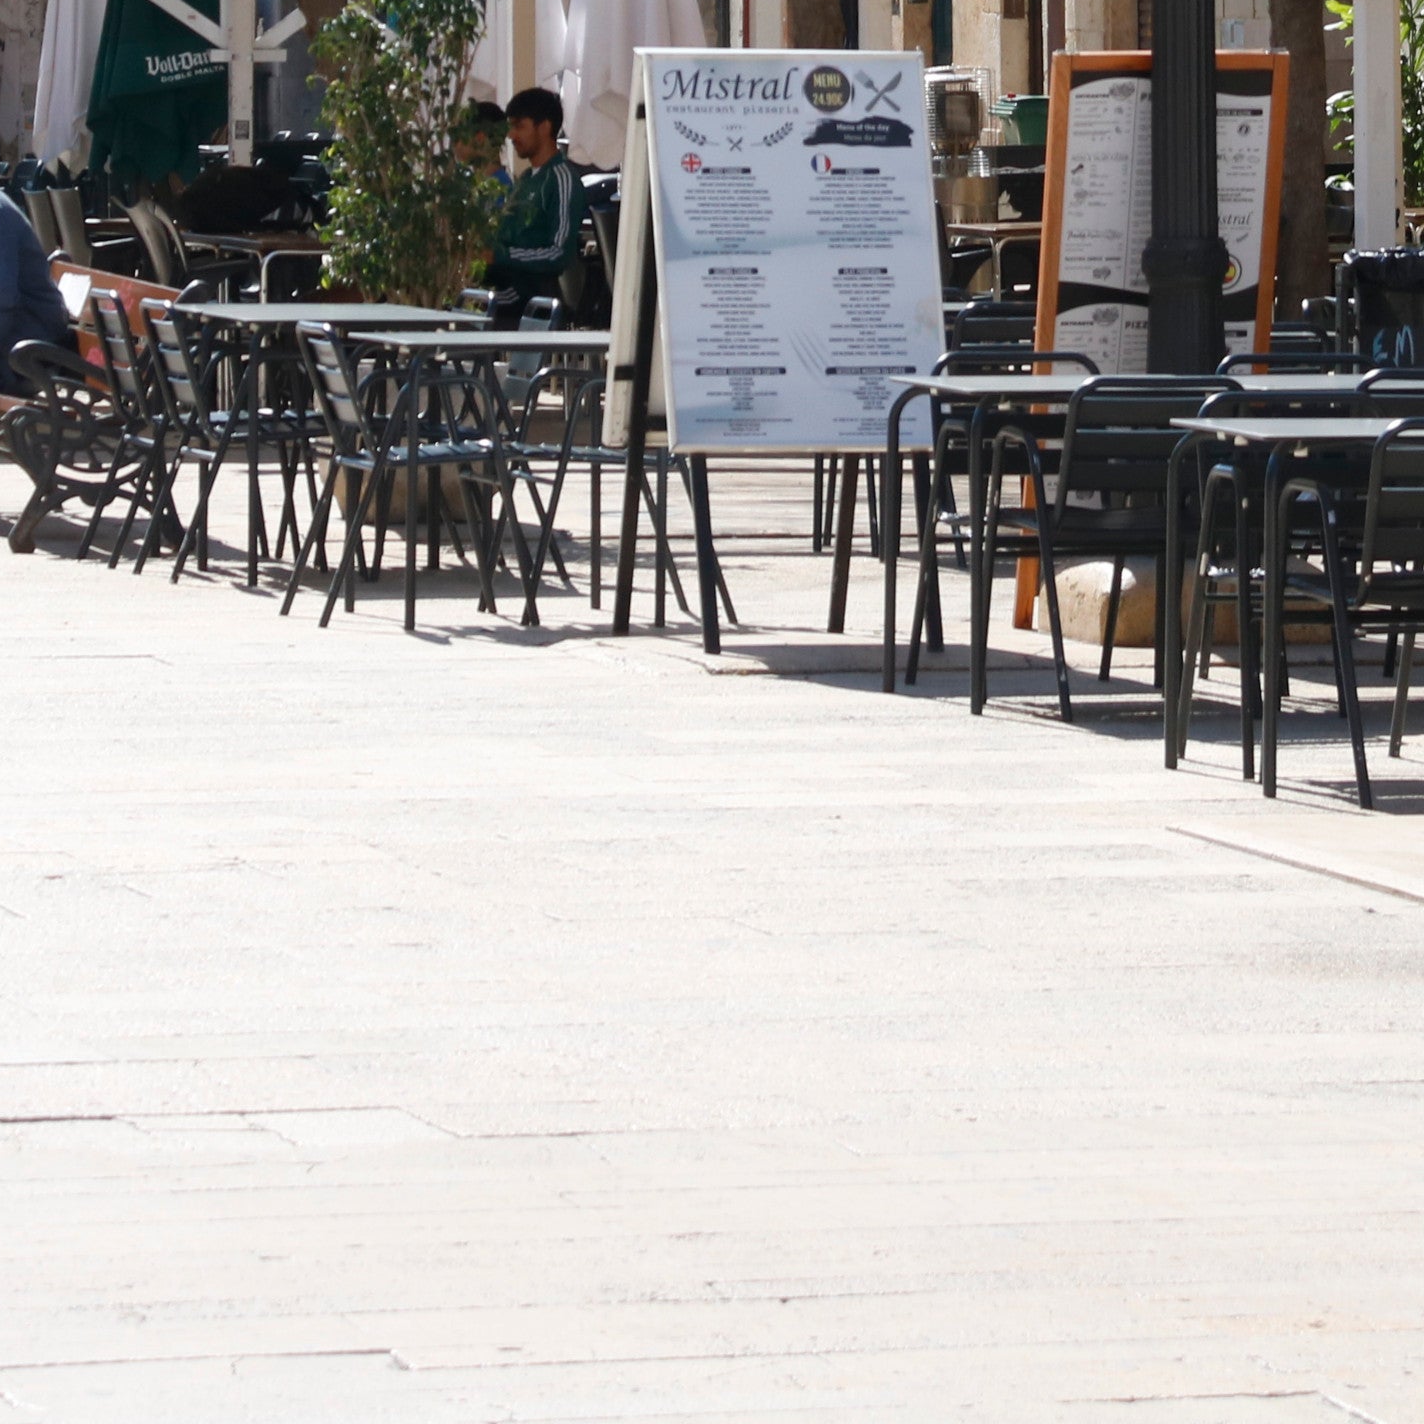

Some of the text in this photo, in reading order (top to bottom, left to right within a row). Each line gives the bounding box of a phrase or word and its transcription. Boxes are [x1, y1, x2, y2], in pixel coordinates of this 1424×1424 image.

[194, 65, 225, 76] MALTA
[662, 66, 799, 101] Mistral
[813, 73, 841, 87] MENU
[666, 105, 799, 115] restaurant pizzeria
